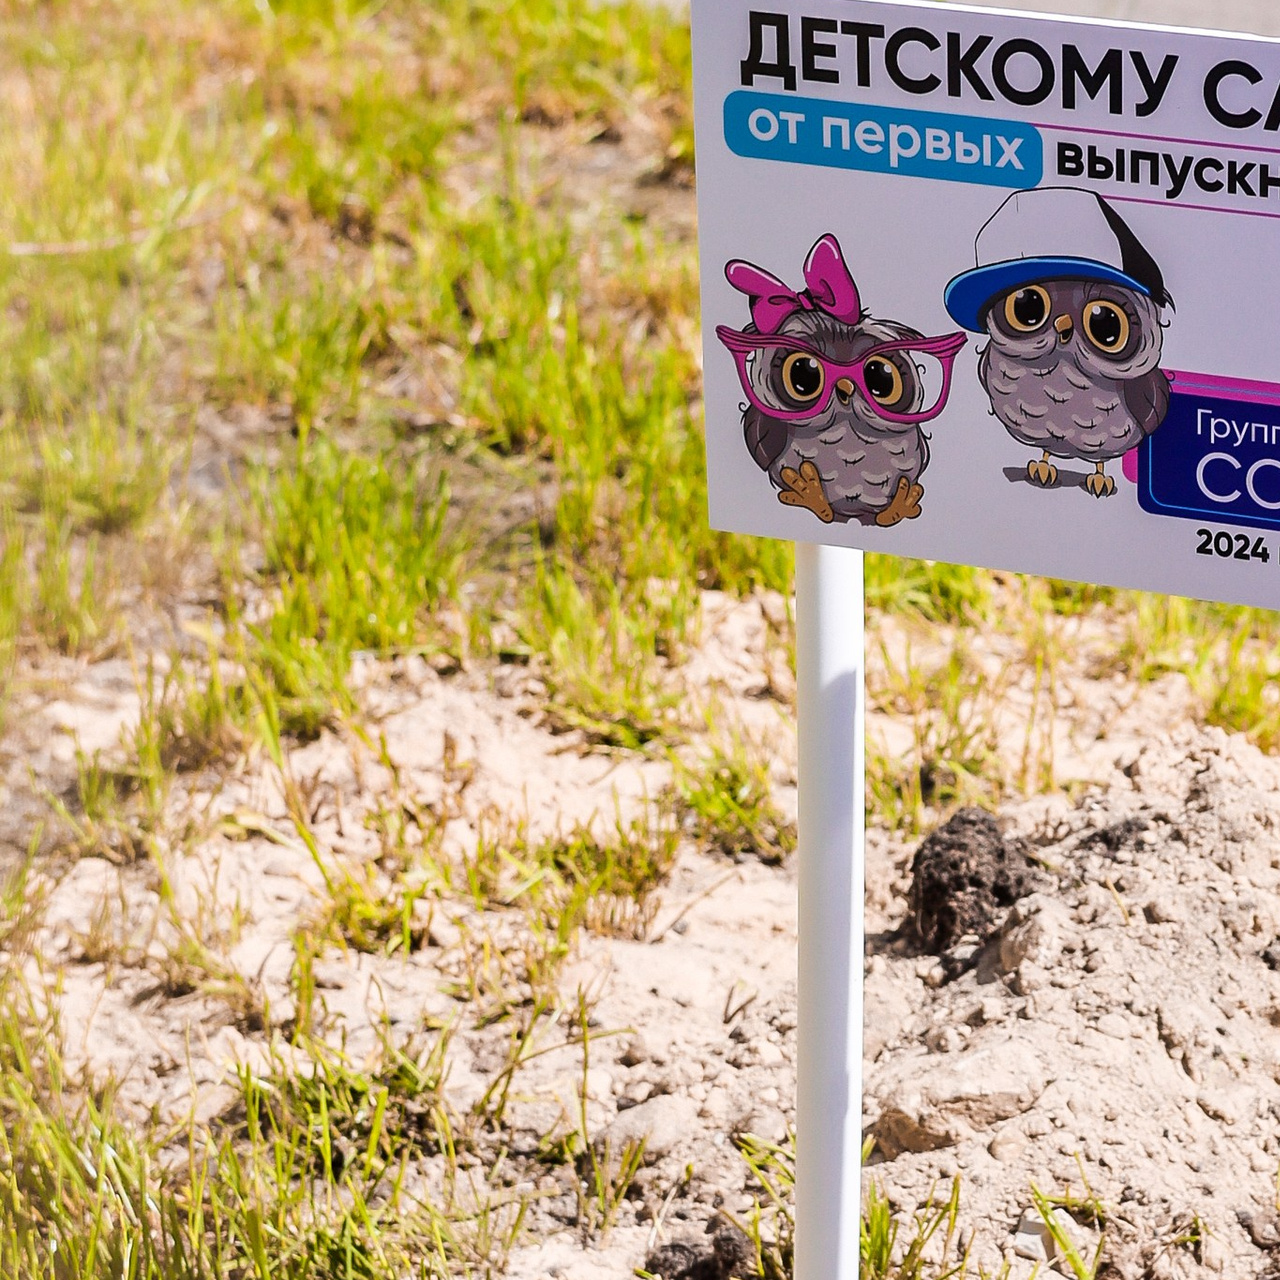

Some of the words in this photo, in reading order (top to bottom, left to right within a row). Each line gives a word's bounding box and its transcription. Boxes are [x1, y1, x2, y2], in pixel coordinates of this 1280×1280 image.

[740, 10, 1179, 117] ДЕТСКОМУ
[748, 108, 805, 144] от
[822, 116, 1025, 169] первых
[1195, 528, 1270, 563] 2024
